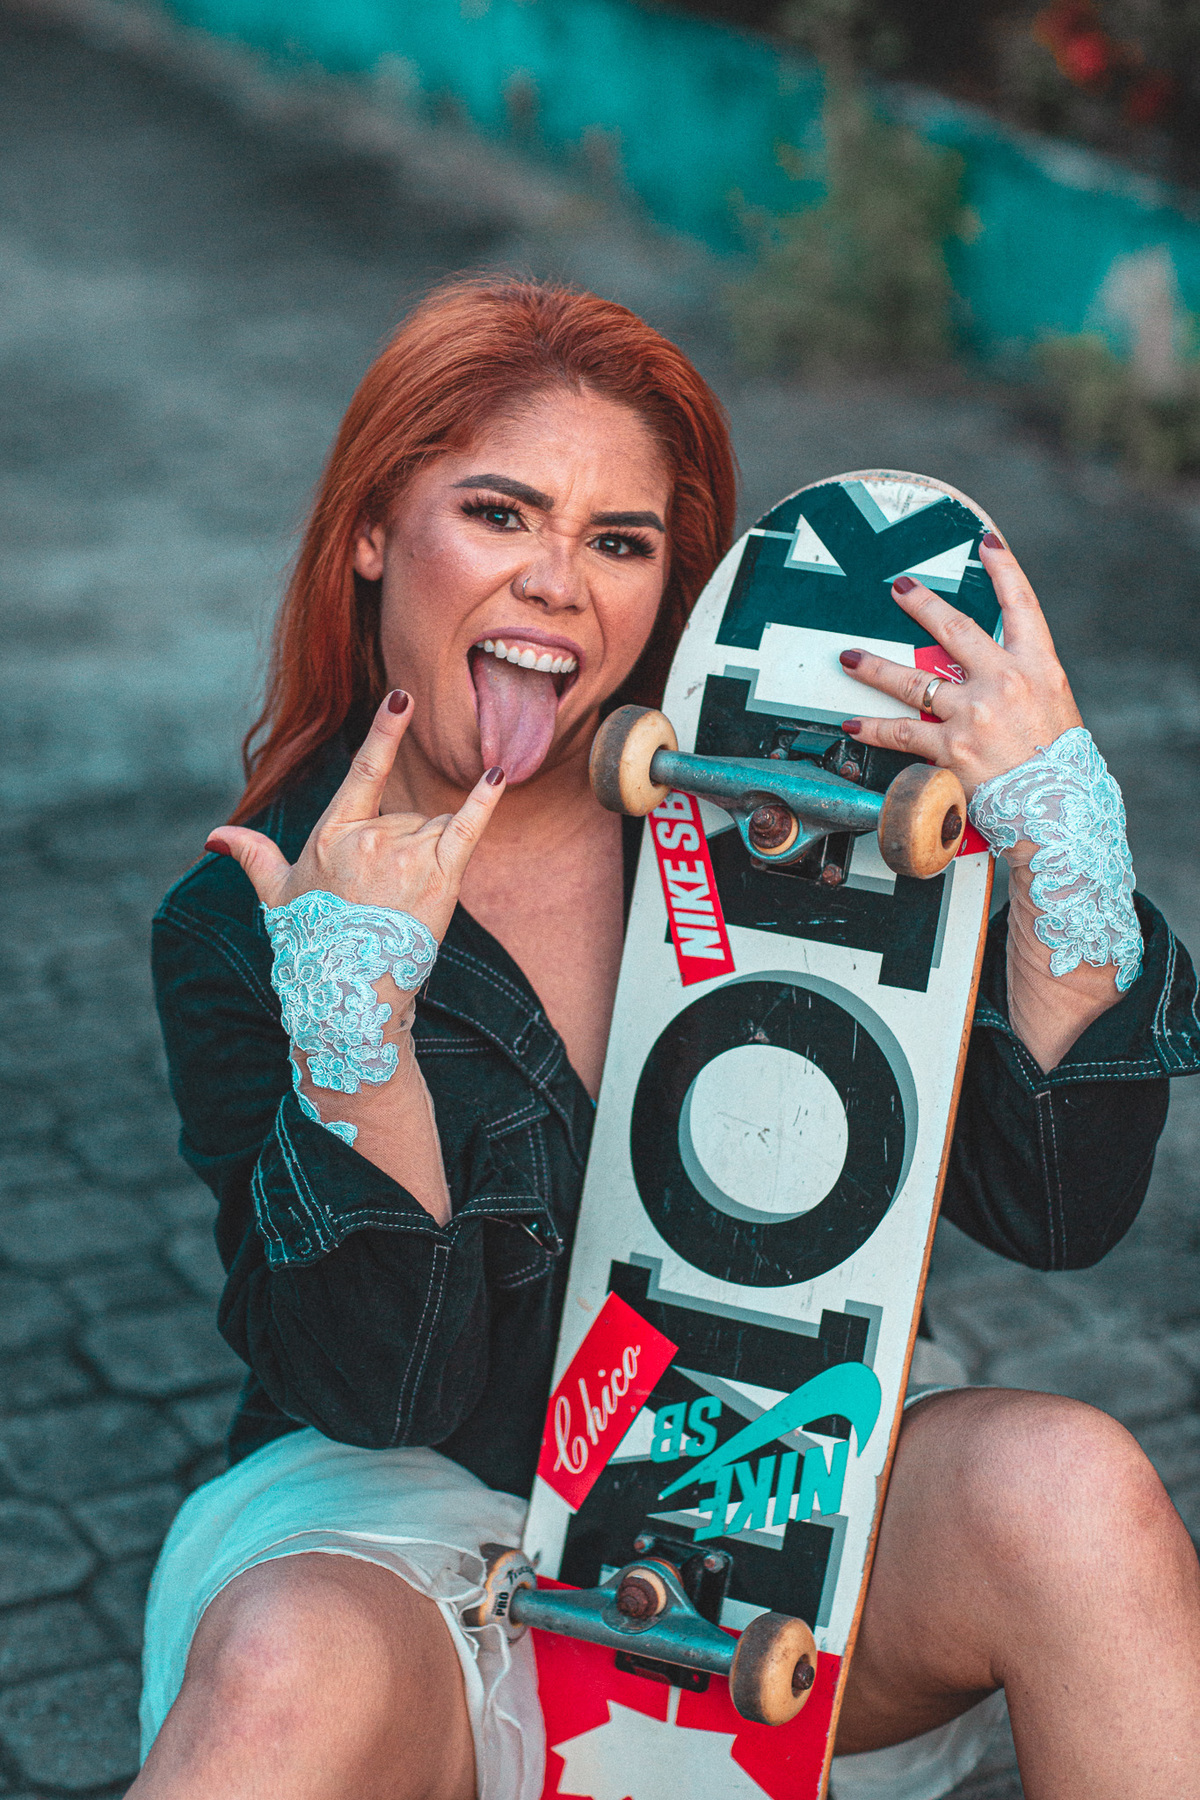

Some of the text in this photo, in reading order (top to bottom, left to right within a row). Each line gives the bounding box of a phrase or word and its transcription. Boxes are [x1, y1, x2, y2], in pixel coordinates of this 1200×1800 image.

[653, 791, 726, 960] NIKE SB
[553, 1344, 641, 1474] Chico
[650, 1396, 722, 1463] SB
[693, 1441, 849, 1542] NIKE
[495, 1591, 509, 1617] PRO
